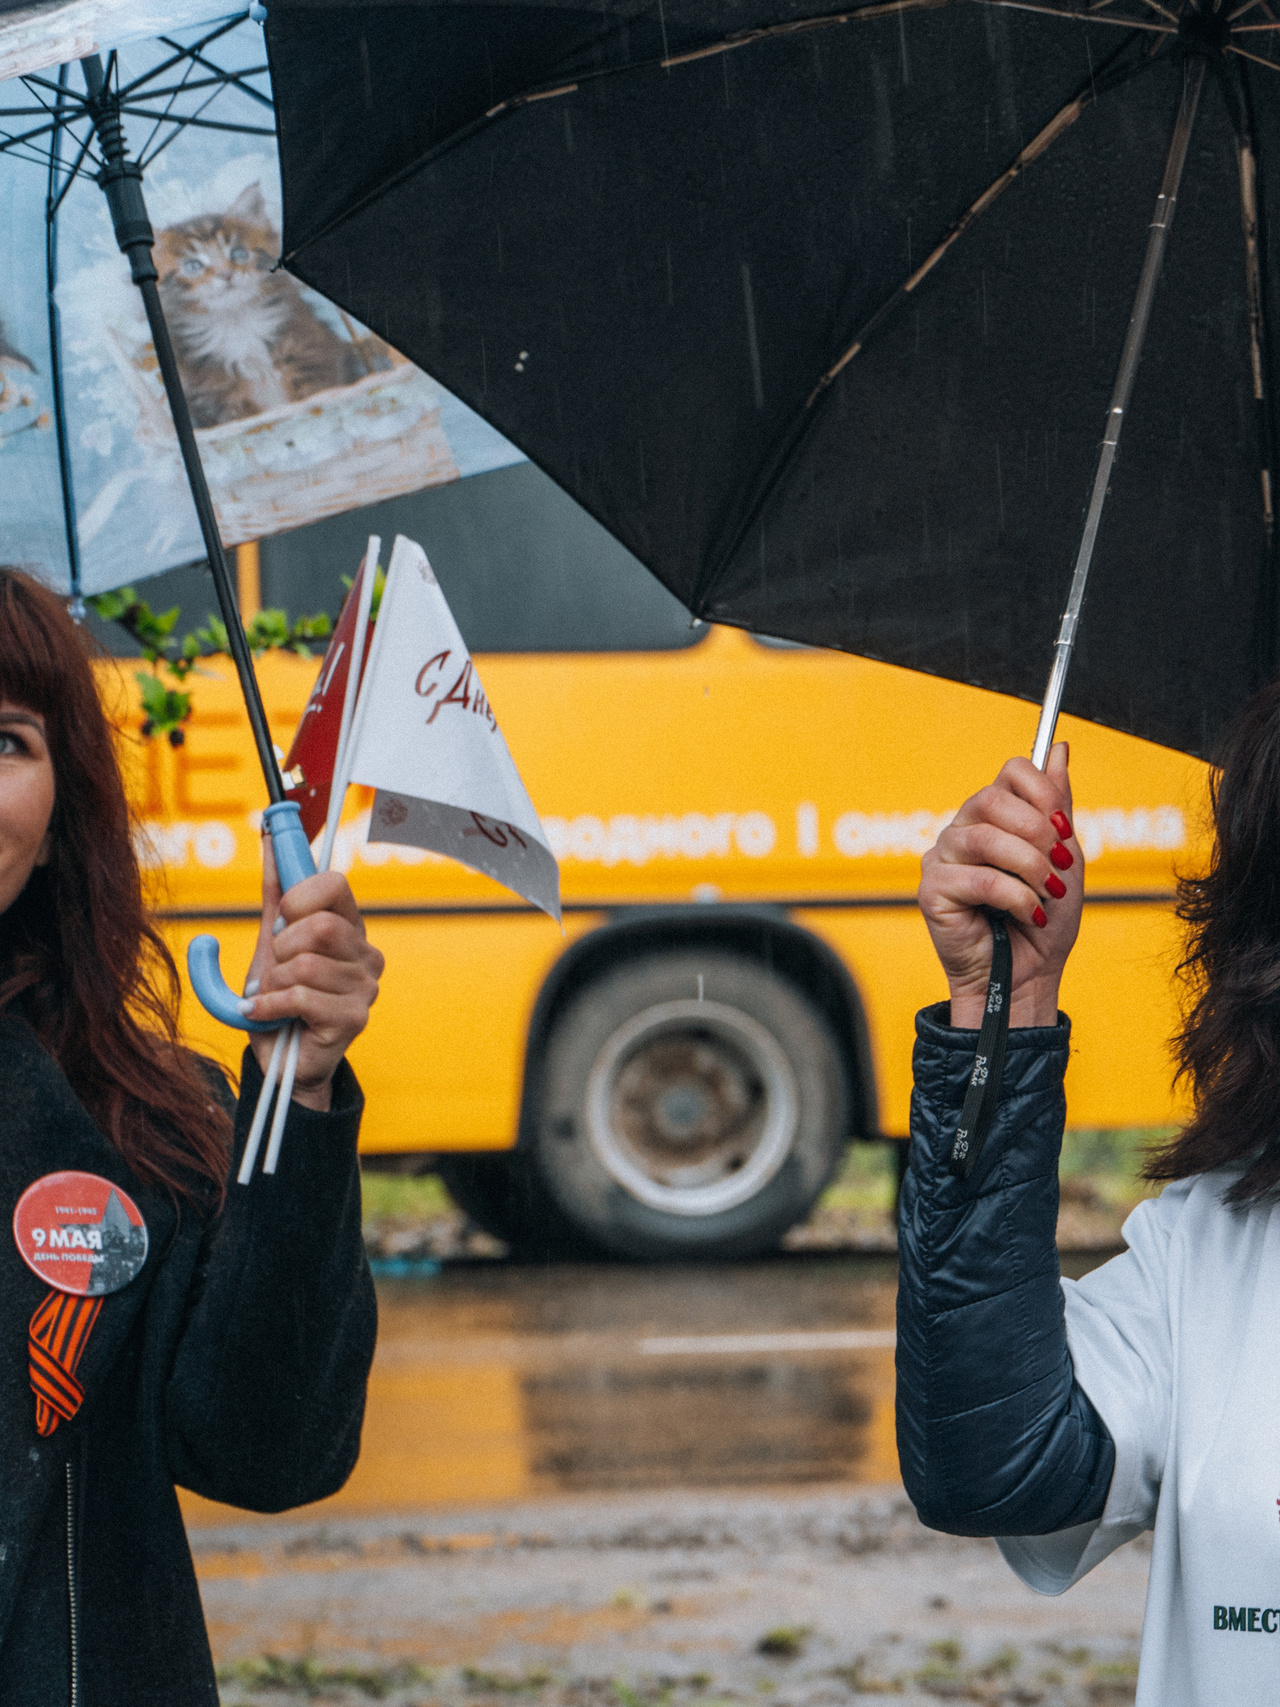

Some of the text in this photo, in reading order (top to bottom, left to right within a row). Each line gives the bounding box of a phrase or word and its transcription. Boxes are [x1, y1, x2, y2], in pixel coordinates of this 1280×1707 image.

[31, 1228, 103, 1250] 9 МАЯ
[33, 1253, 105, 1263] ДЕНЬ ПОБЕДЫ
